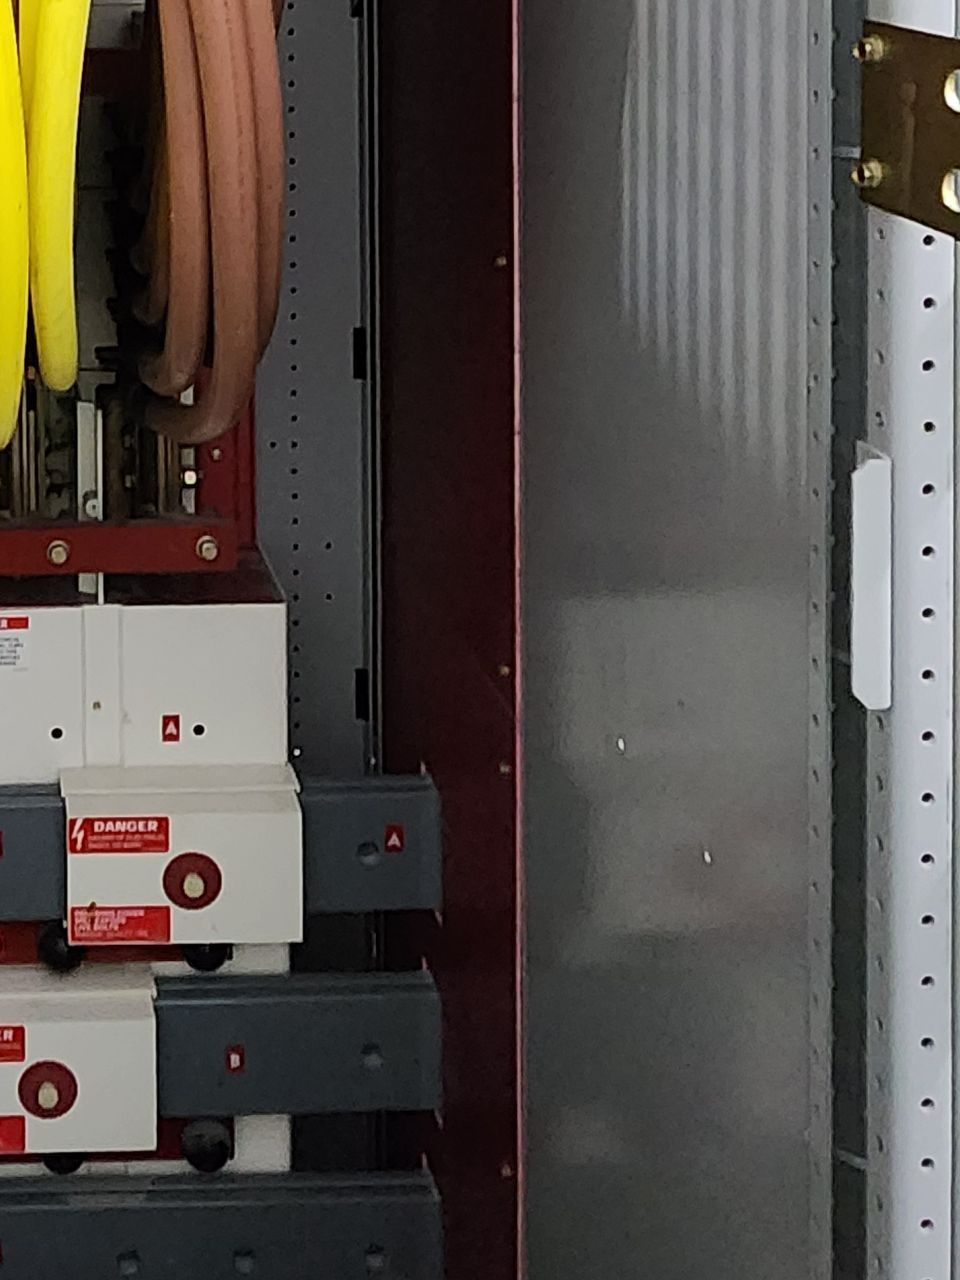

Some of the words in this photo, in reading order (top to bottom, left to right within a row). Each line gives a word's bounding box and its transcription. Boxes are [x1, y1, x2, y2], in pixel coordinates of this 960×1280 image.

[165, 720, 177, 735] A
[94, 821, 158, 832] DANGER
[387, 832, 401, 847] A
[230, 1053, 240, 1069] B
